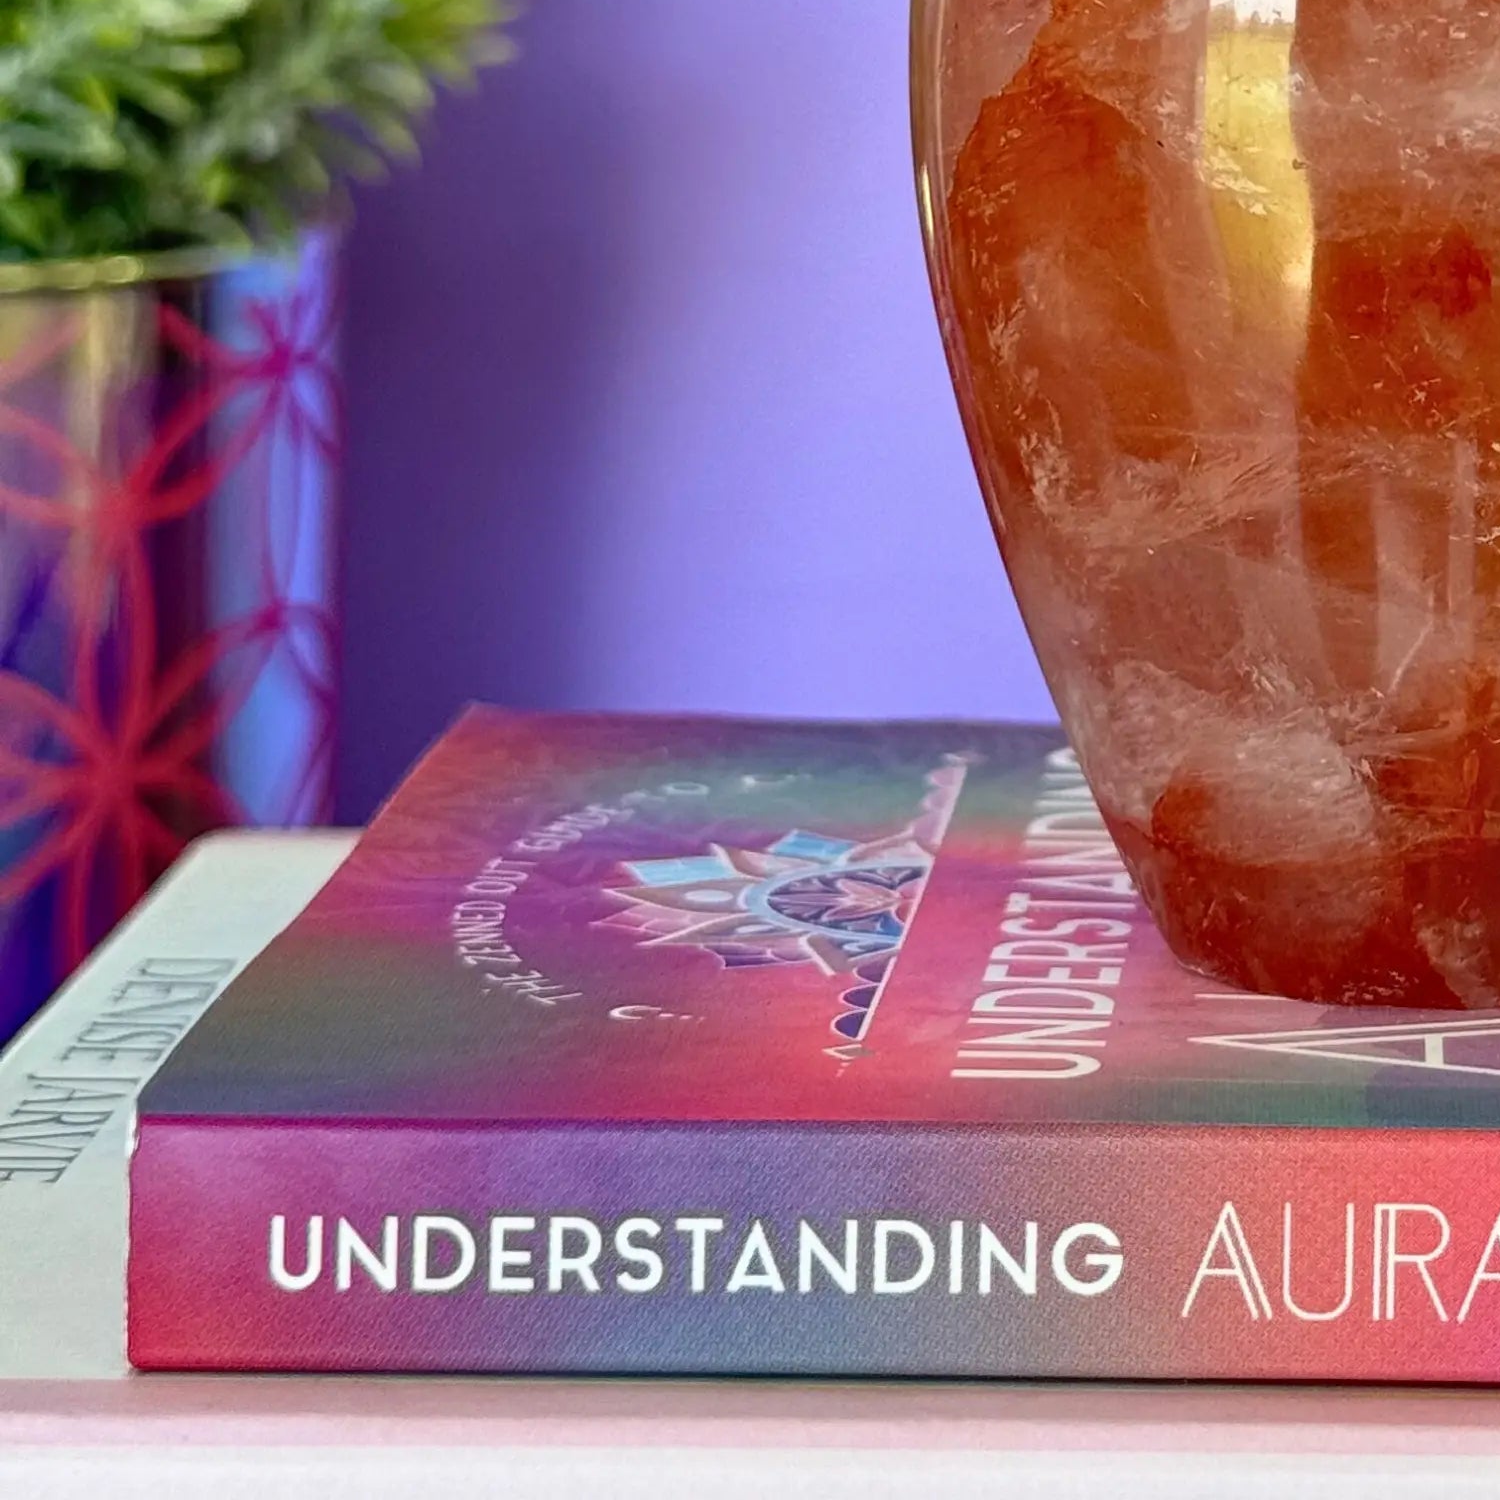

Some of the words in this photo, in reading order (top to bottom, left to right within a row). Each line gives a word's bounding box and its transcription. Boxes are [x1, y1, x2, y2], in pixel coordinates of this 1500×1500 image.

[465, 857, 538, 894] OUT
[453, 900, 521, 966] ZENNED
[951, 747, 1138, 1079] UNDERSTAND
[486, 970, 583, 1005] THE
[268, 1214, 1125, 1296] UNDERSTANDING
